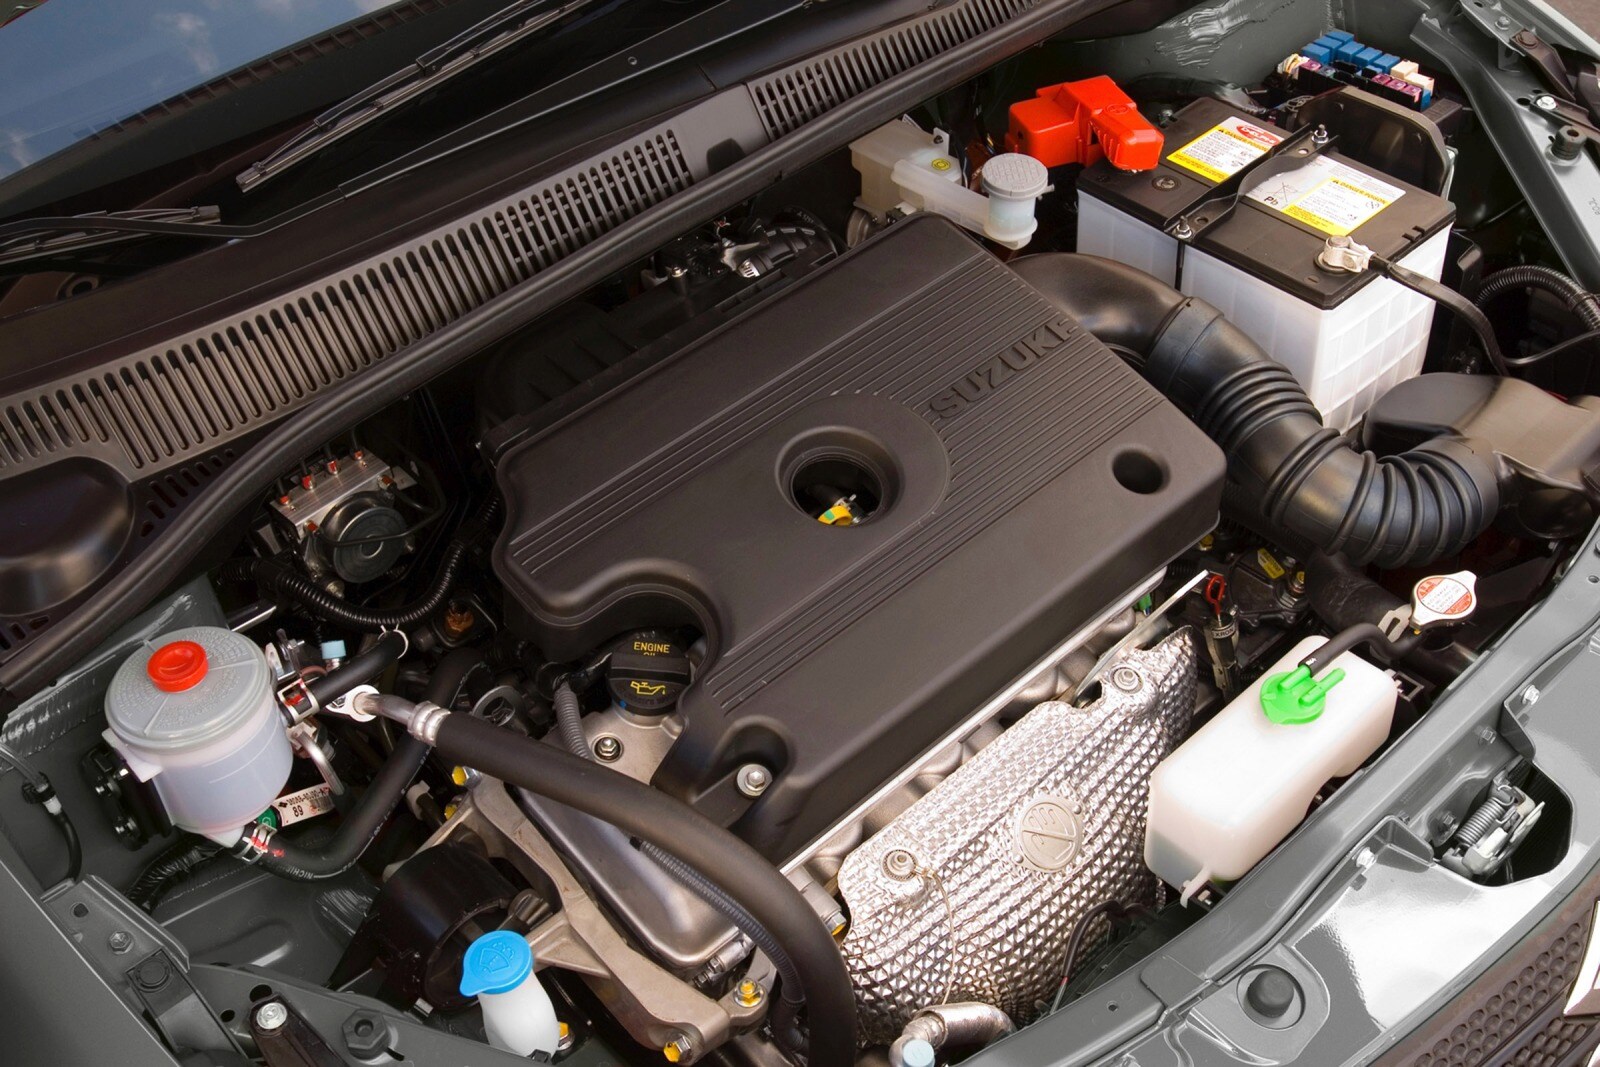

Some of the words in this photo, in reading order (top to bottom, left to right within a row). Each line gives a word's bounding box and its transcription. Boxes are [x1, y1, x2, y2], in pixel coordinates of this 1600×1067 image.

[1264, 196, 1279, 206] Pb
[929, 320, 1071, 419] SUZUKI
[633, 641, 671, 654] ENGINE
